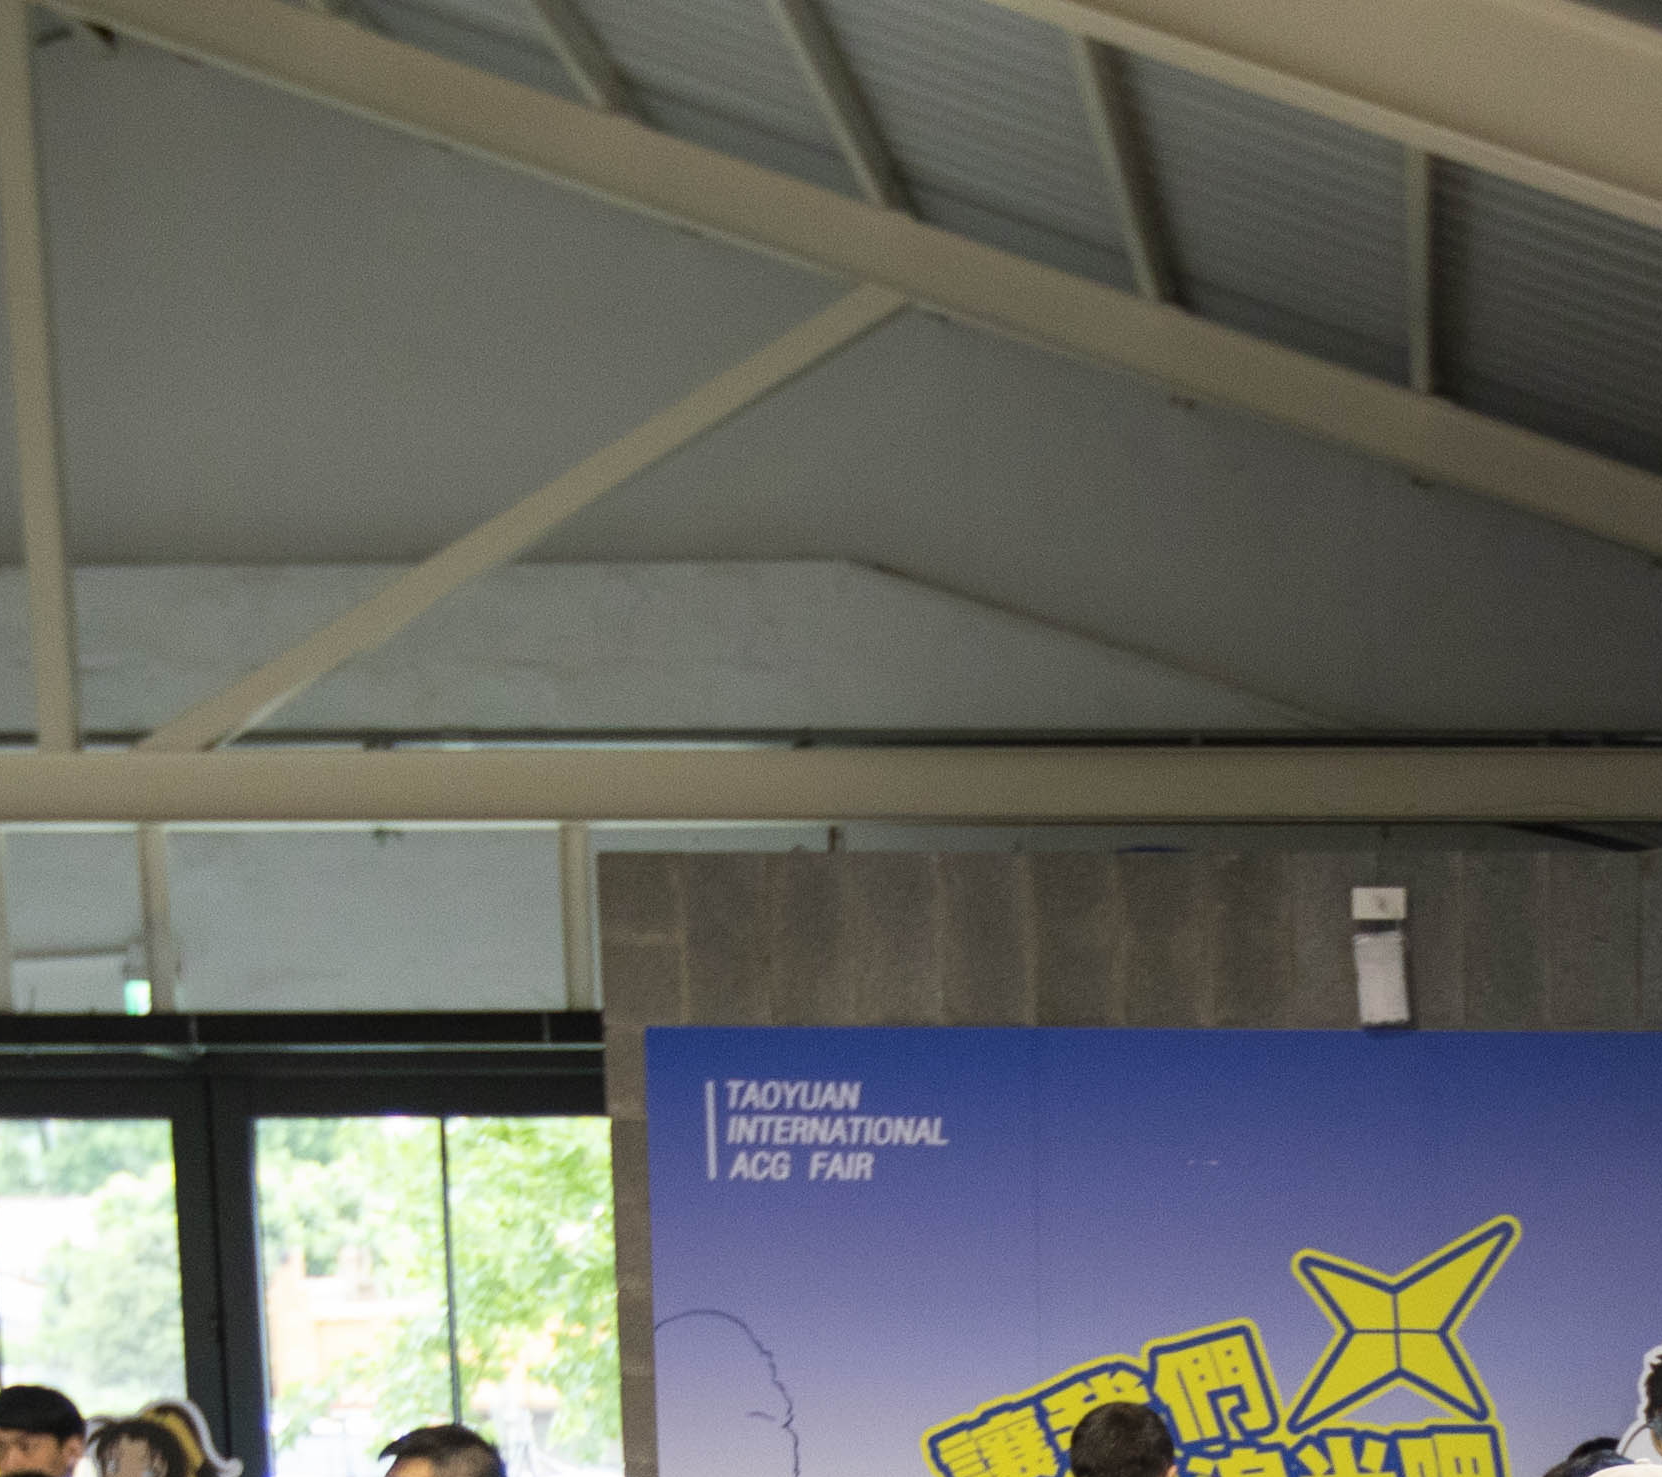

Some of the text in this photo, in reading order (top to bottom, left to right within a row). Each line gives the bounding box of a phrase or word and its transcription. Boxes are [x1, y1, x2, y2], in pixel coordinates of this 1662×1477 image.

[725, 1079, 861, 1111] TAOYUAN
[726, 1115, 950, 1146] INTERNATIONAL
[729, 1150, 875, 1181] ACG FAIR
